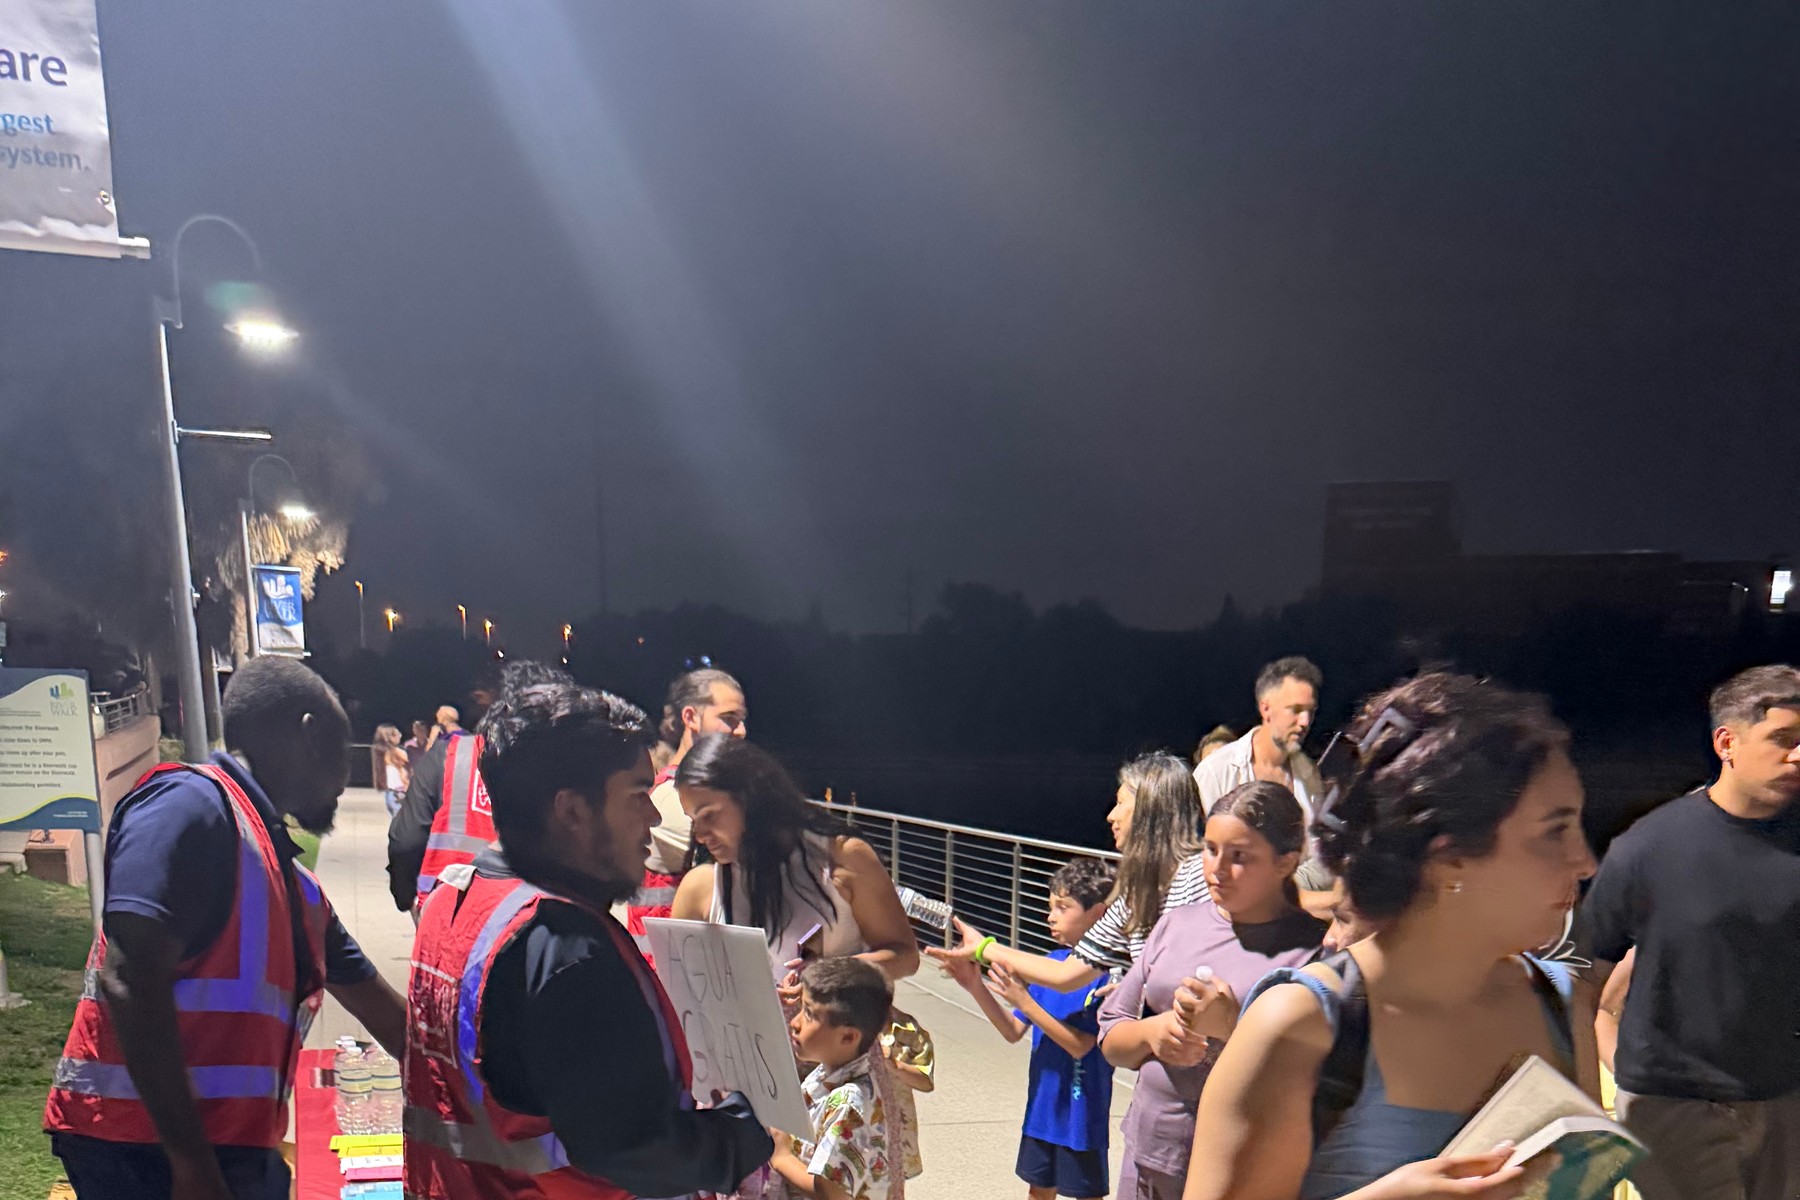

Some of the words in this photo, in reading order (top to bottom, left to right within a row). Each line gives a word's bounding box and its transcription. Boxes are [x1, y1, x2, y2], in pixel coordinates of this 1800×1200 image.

[0, 48, 68, 87] are
[0, 113, 56, 137] gest
[668, 928, 739, 1004] AGUA
